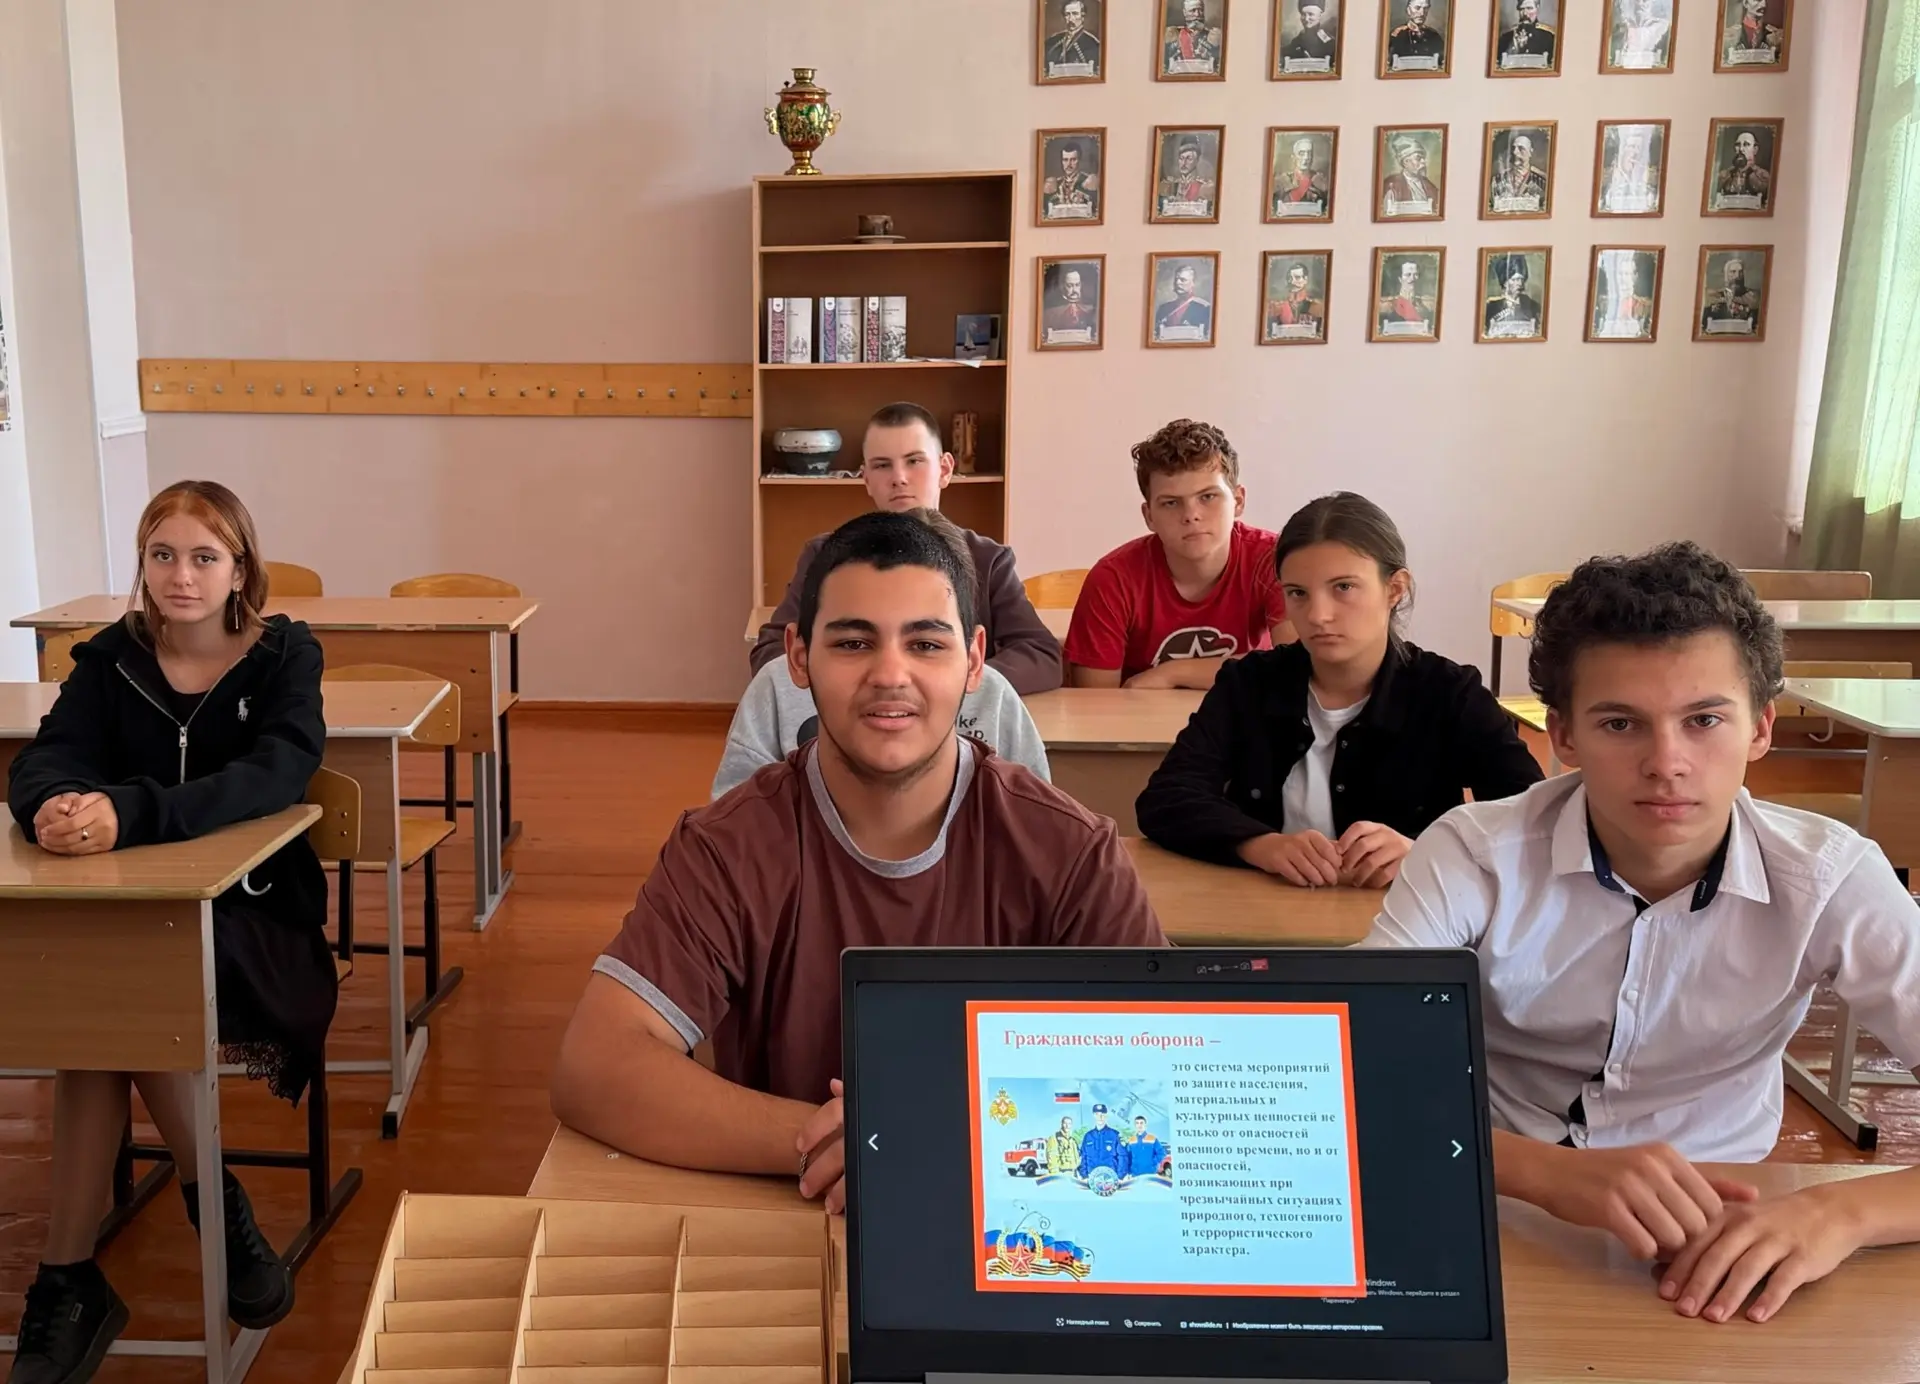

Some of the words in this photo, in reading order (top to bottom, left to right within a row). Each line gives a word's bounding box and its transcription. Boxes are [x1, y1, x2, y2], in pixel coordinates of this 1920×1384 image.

[1004, 1030, 1124, 1049] Гражданская
[1131, 1032, 1204, 1051] оборона
[1172, 1064, 1191, 1072] это
[1194, 1064, 1243, 1072] система
[1247, 1063, 1330, 1075] мероприятий
[1192, 1080, 1236, 1089] защите
[1240, 1080, 1308, 1090] населения,
[1175, 1096, 1265, 1106] материальных
[1176, 1112, 1250, 1123] культурных
[1254, 1112, 1317, 1123] ценностей
[1321, 1114, 1335, 1122] не
[1176, 1129, 1218, 1137] только
[1239, 1129, 1308, 1138] опасностей
[1178, 1146, 1233, 1154] военного
[1237, 1146, 1292, 1157] времени,
[1296, 1147, 1310, 1155] но
[1315, 1147, 1321, 1155] и
[1178, 1162, 1251, 1172] опасностей,
[1180, 1178, 1266, 1188] возникающих
[1270, 1179, 1292, 1190] при
[1180, 1195, 1273, 1206] чрезвычайных
[1277, 1196, 1342, 1207] ситуациях
[1181, 1211, 1256, 1223] природного,
[1260, 1213, 1342, 1222] техногенного
[1193, 1229, 1313, 1240] террористического
[1183, 1246, 1250, 1256] характера.
